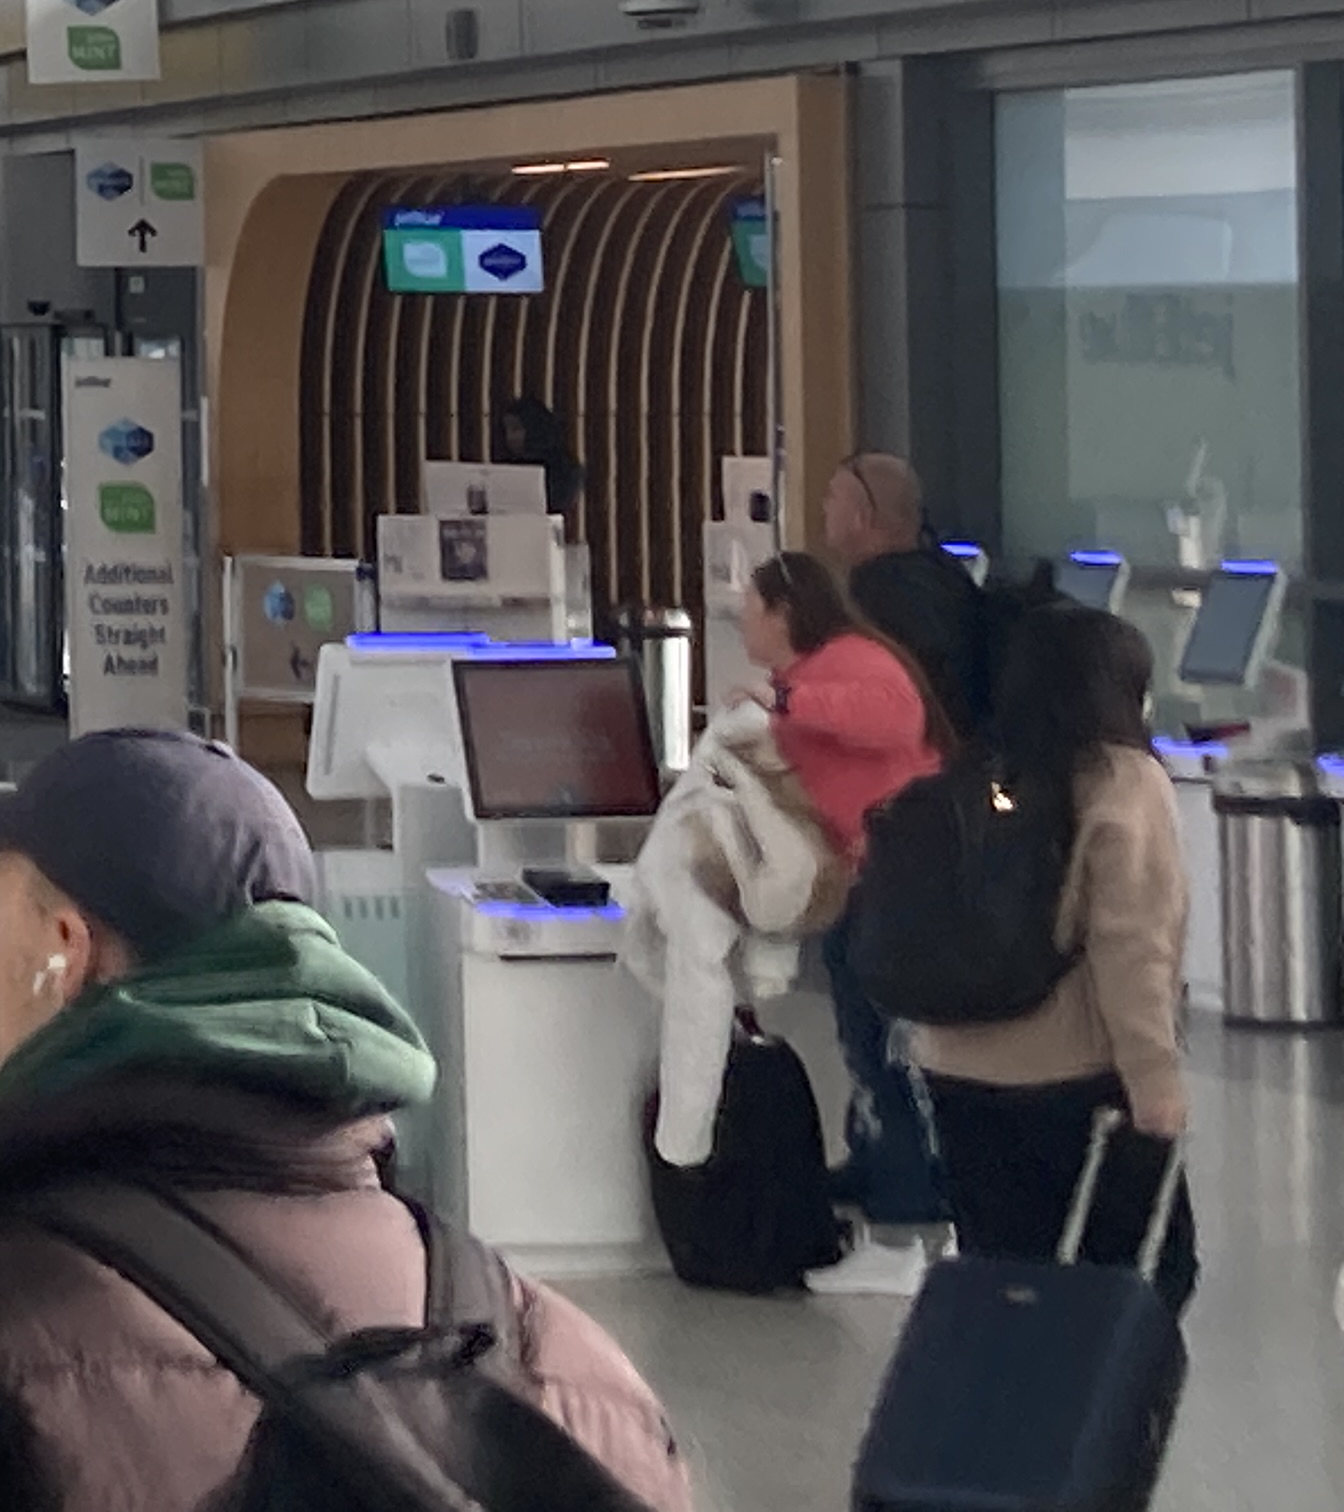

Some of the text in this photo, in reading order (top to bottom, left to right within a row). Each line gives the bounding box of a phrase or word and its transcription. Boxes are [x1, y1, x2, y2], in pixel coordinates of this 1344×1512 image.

[84, 562, 174, 584] Additional
[89, 592, 170, 616] Counters
[94, 623, 166, 650] Straight
[103, 653, 159, 676] Ahead
